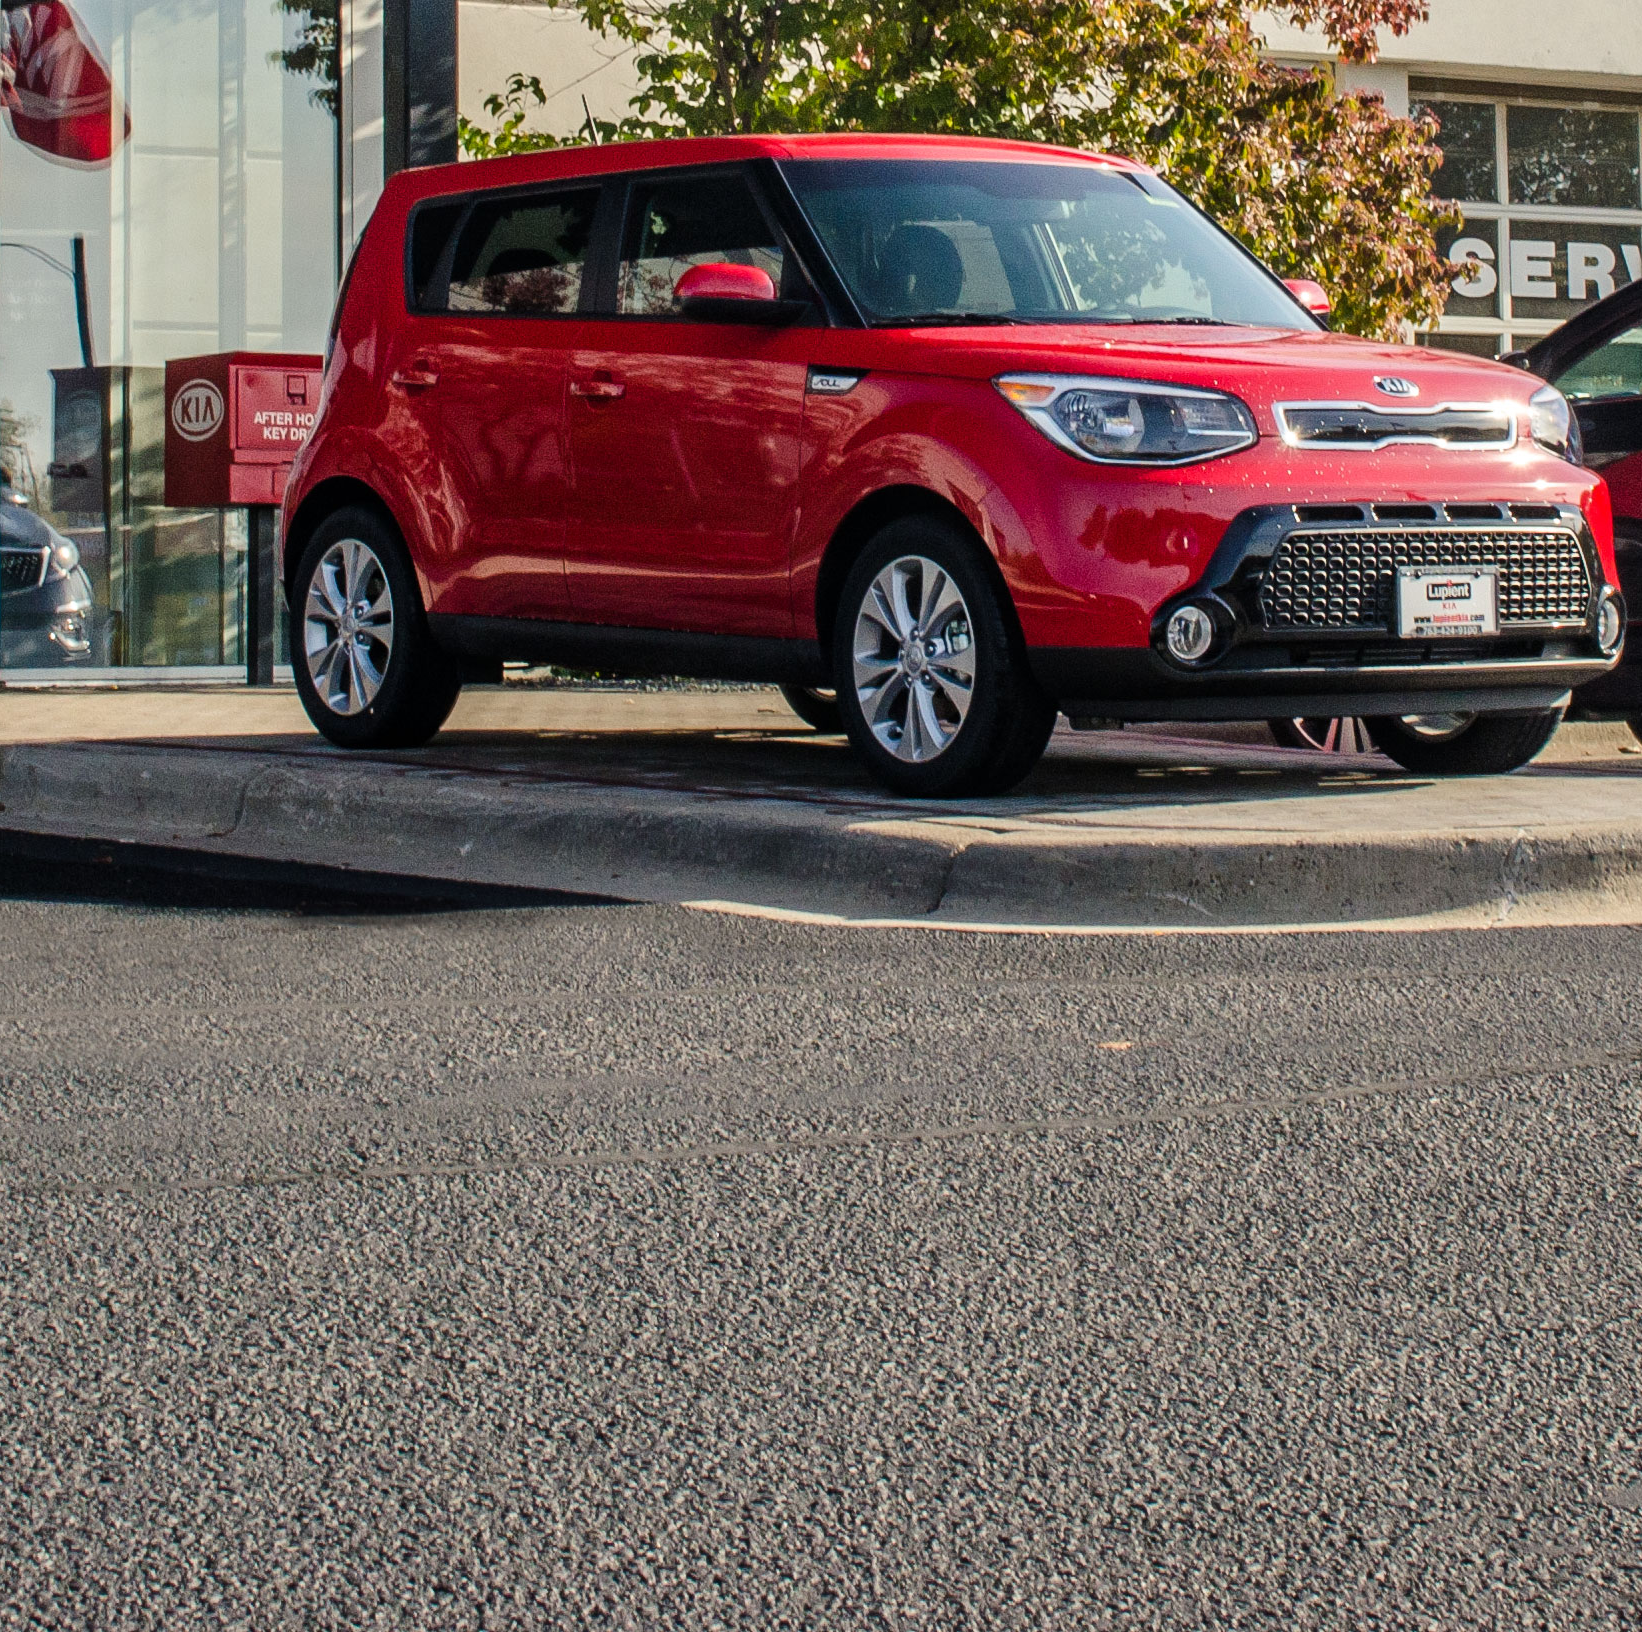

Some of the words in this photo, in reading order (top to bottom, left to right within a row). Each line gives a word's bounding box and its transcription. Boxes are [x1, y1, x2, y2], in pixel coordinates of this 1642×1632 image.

[1381, 377, 1411, 393] KIA
[180, 395, 216, 424] KIA
[254, 412, 293, 426] AFTER
[263, 426, 287, 440] KEY
[1428, 581, 1470, 601] Lupient
[1442, 602, 1457, 610] KIA
